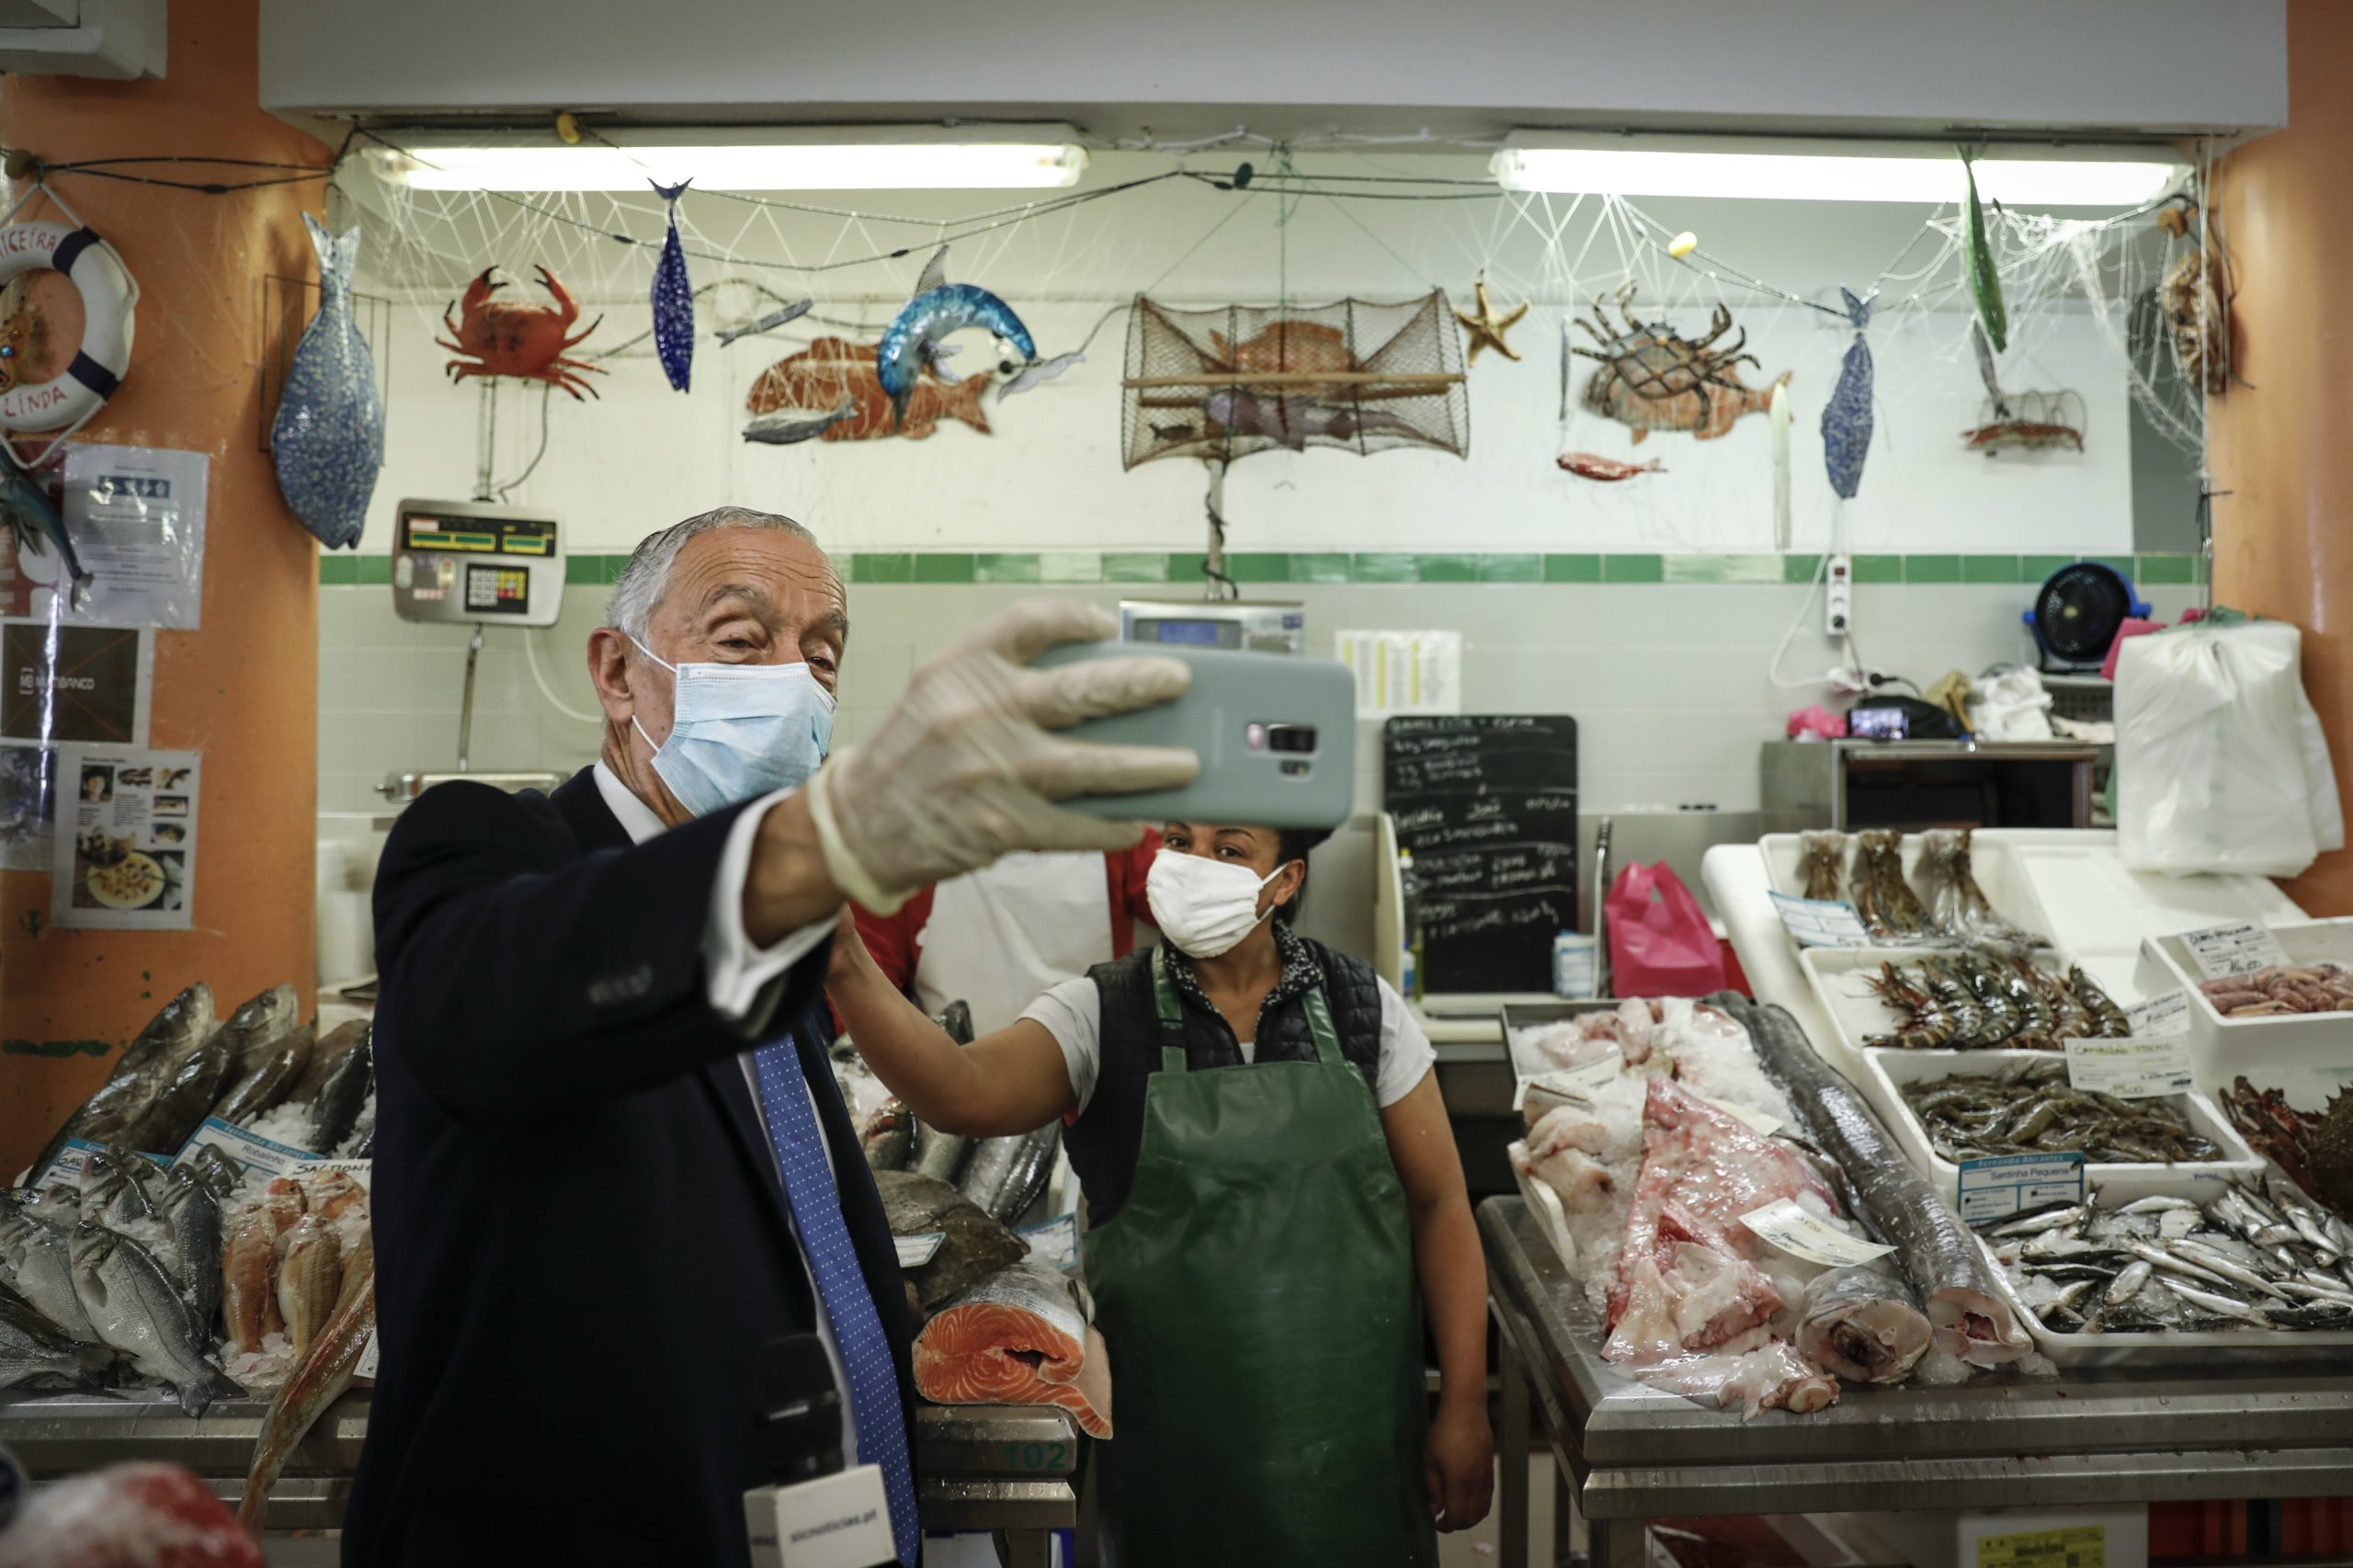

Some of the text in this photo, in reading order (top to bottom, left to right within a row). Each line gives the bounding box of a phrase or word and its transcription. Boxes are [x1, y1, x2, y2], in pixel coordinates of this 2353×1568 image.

[242, 1143, 285, 1166] Robalinho
[1991, 1169, 2029, 1180] Sardinha
[2029, 1167, 2069, 1177] Pequena
[1002, 1442, 1067, 1470] 102
[790, 1508, 879, 1544] sicnoticias.pt
